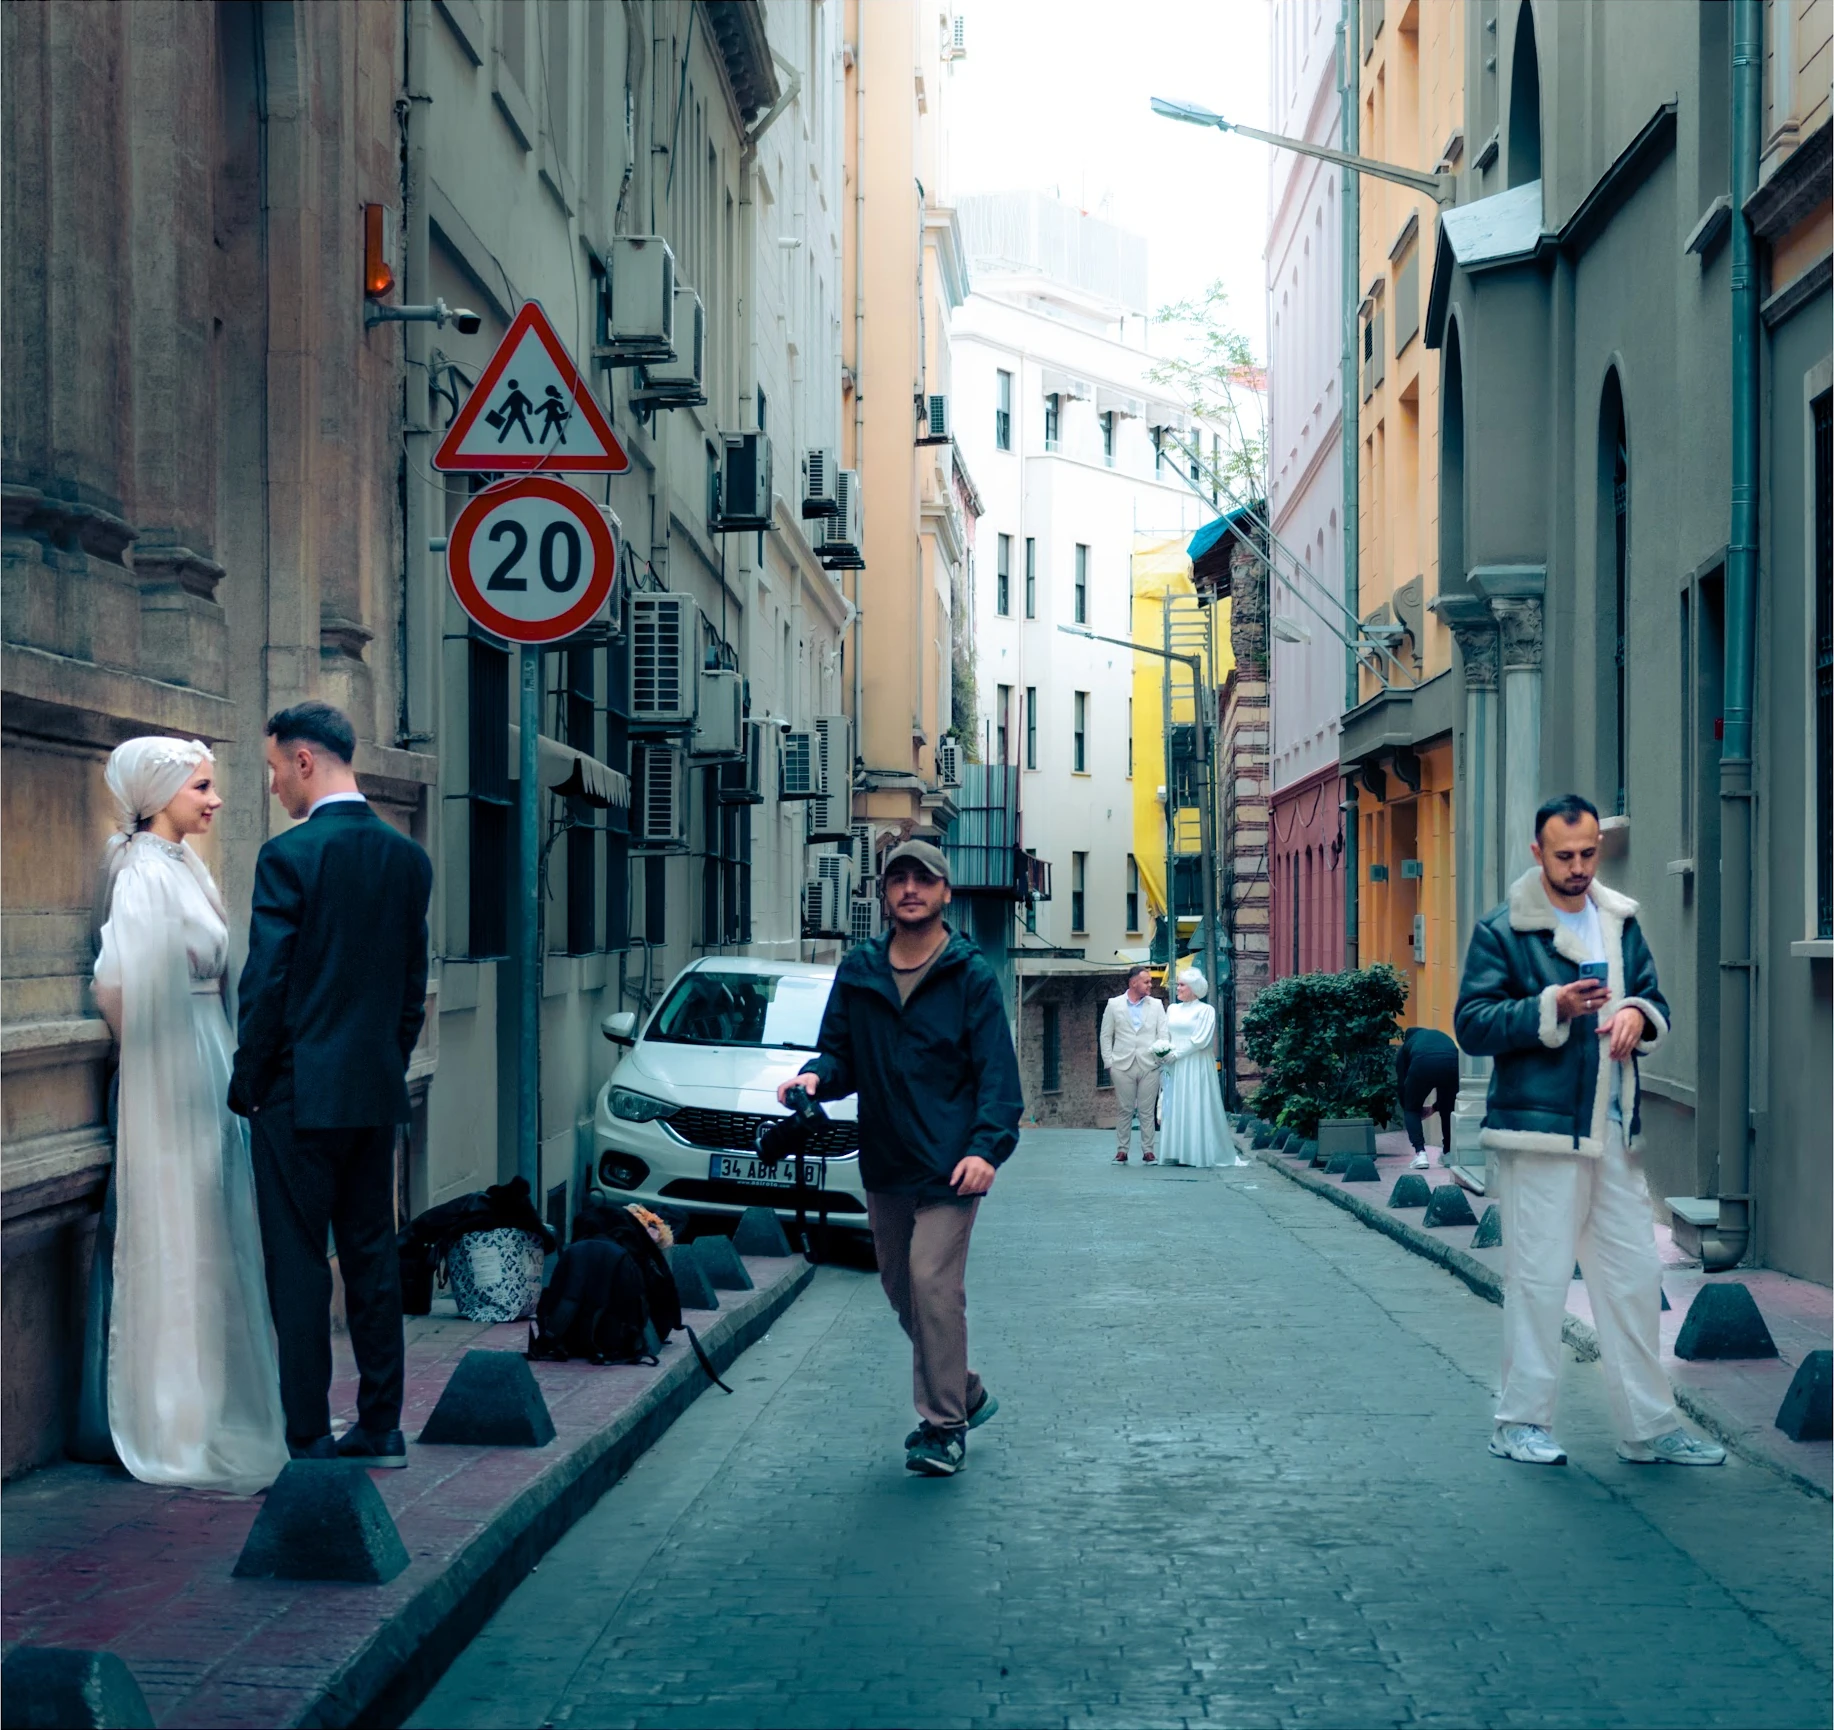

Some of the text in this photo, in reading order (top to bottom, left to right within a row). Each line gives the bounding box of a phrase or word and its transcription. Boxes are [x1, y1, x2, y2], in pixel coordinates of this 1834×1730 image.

[486, 519, 582, 593] 20
[721, 1159, 814, 1183] 34 ABR 48
